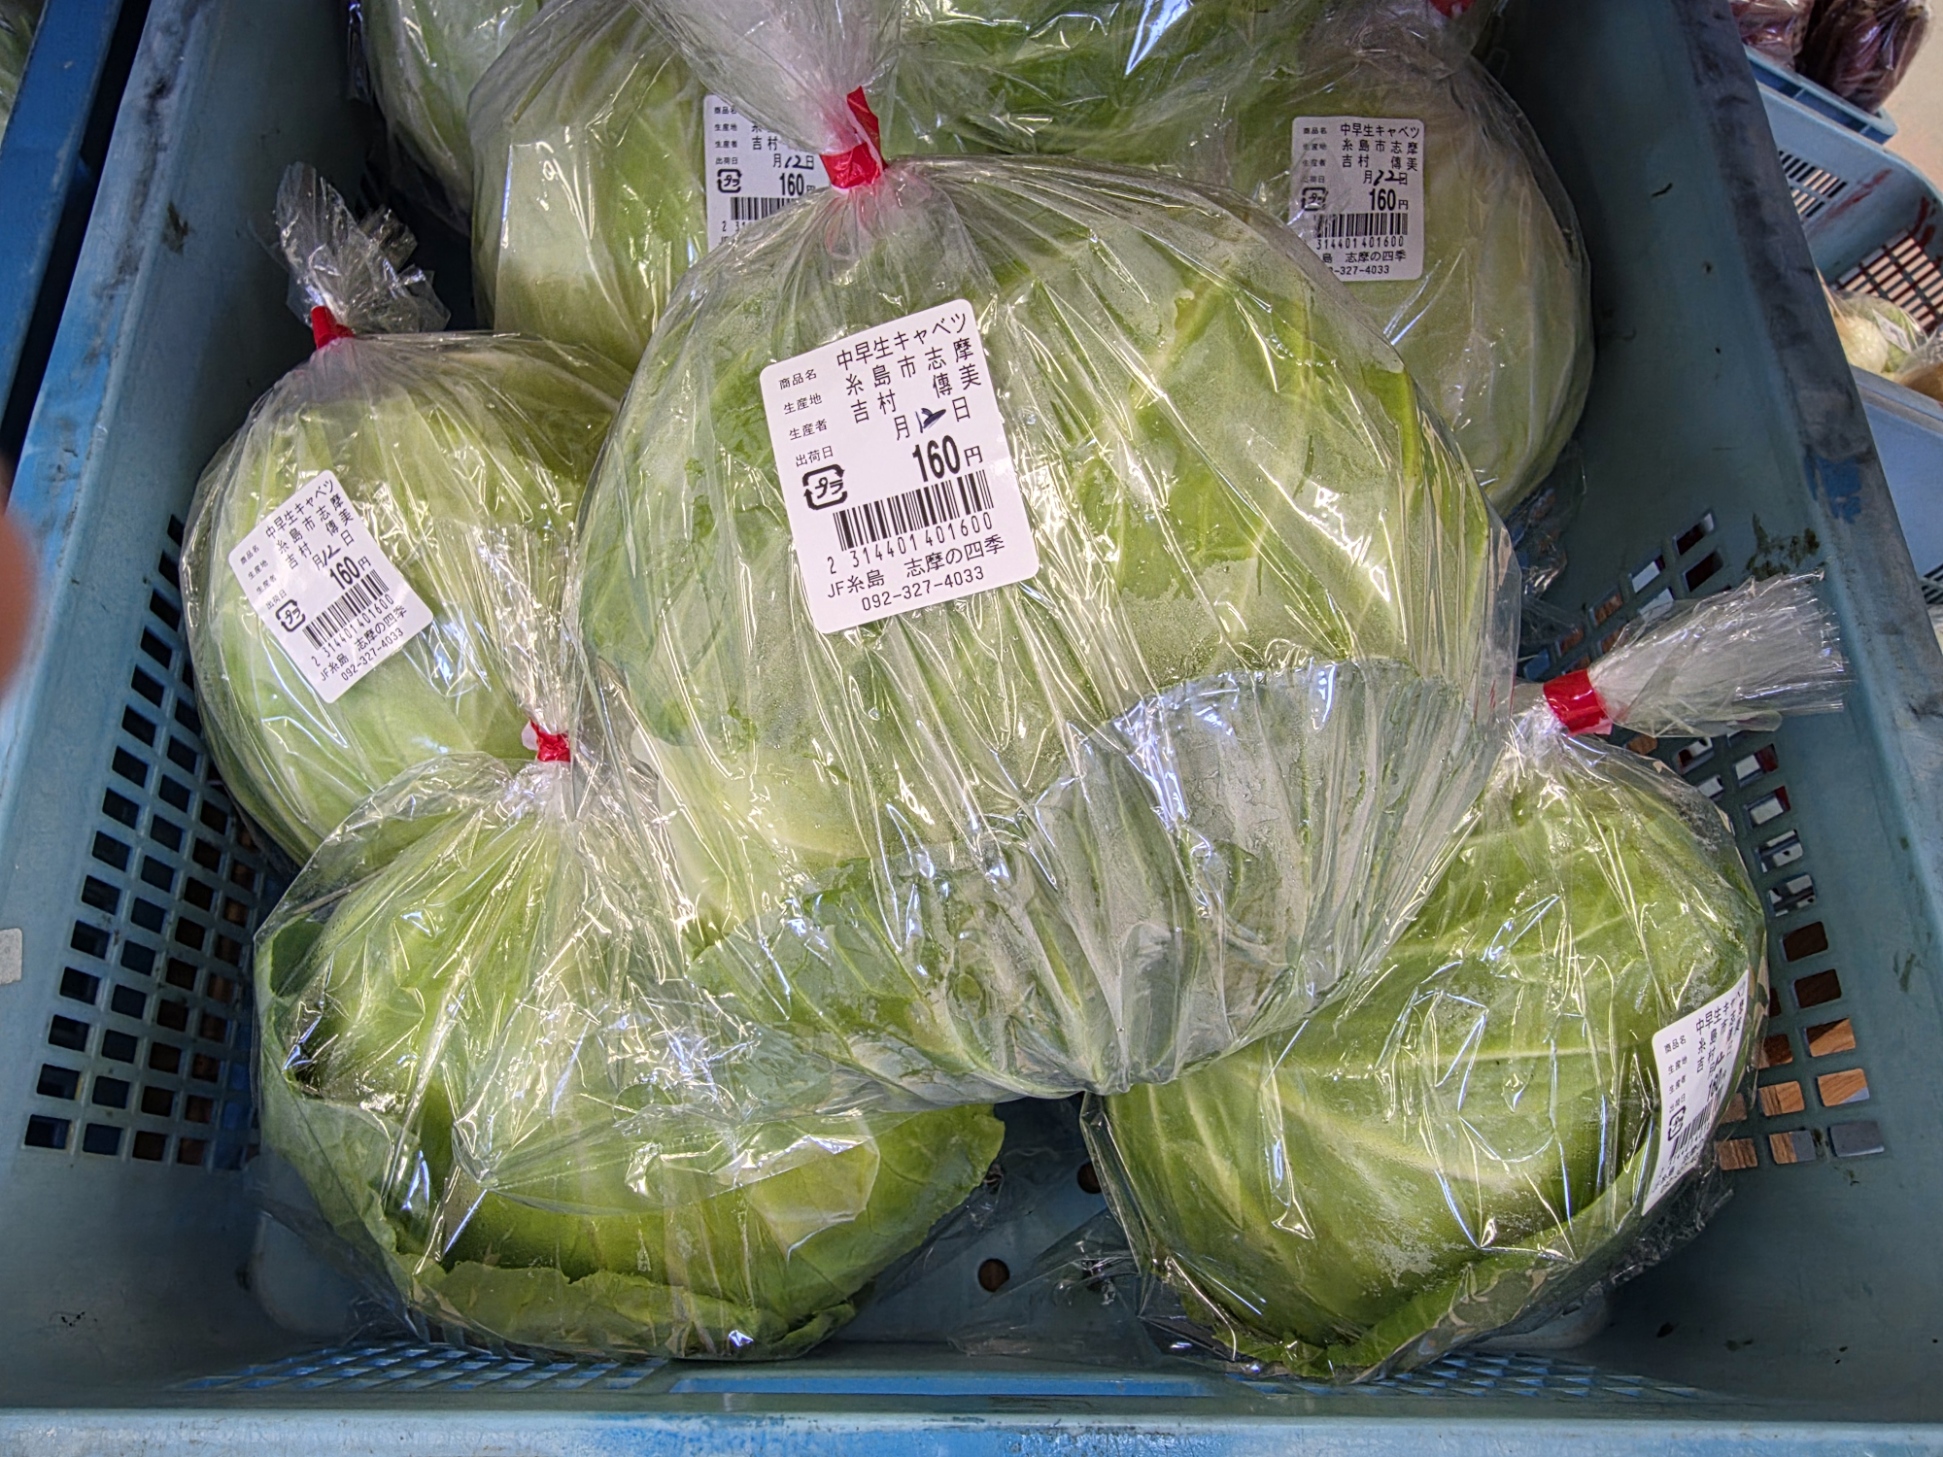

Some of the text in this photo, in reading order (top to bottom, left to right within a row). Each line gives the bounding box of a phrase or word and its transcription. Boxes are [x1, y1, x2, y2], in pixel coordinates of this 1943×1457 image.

[1340, 123, 1420, 138] 中早生キャベツ
[752, 136, 778, 151] 吉村
[1342, 154, 1369, 168] 吉村
[722, 221, 726, 232] 2
[1345, 250, 1406, 263] 志摩の四季
[780, 313, 966, 390] 商品名 中早生キャベツ
[784, 393, 822, 414] 生産地
[789, 418, 828, 440] 生産者
[851, 389, 896, 424] 吉村
[795, 446, 834, 467] 出荷日
[266, 480, 334, 540] 中早生キャベツ
[285, 541, 312, 570] 吉村
[827, 556, 837, 575] 2
[827, 534, 1005, 599] JF糸島 志摩の四季
[862, 566, 984, 611] 092-327-4033
[320, 605, 407, 682] JF糸島 志摩の四季
[312, 656, 320, 668] 2
[341, 628, 404, 681] 092-327-4033
